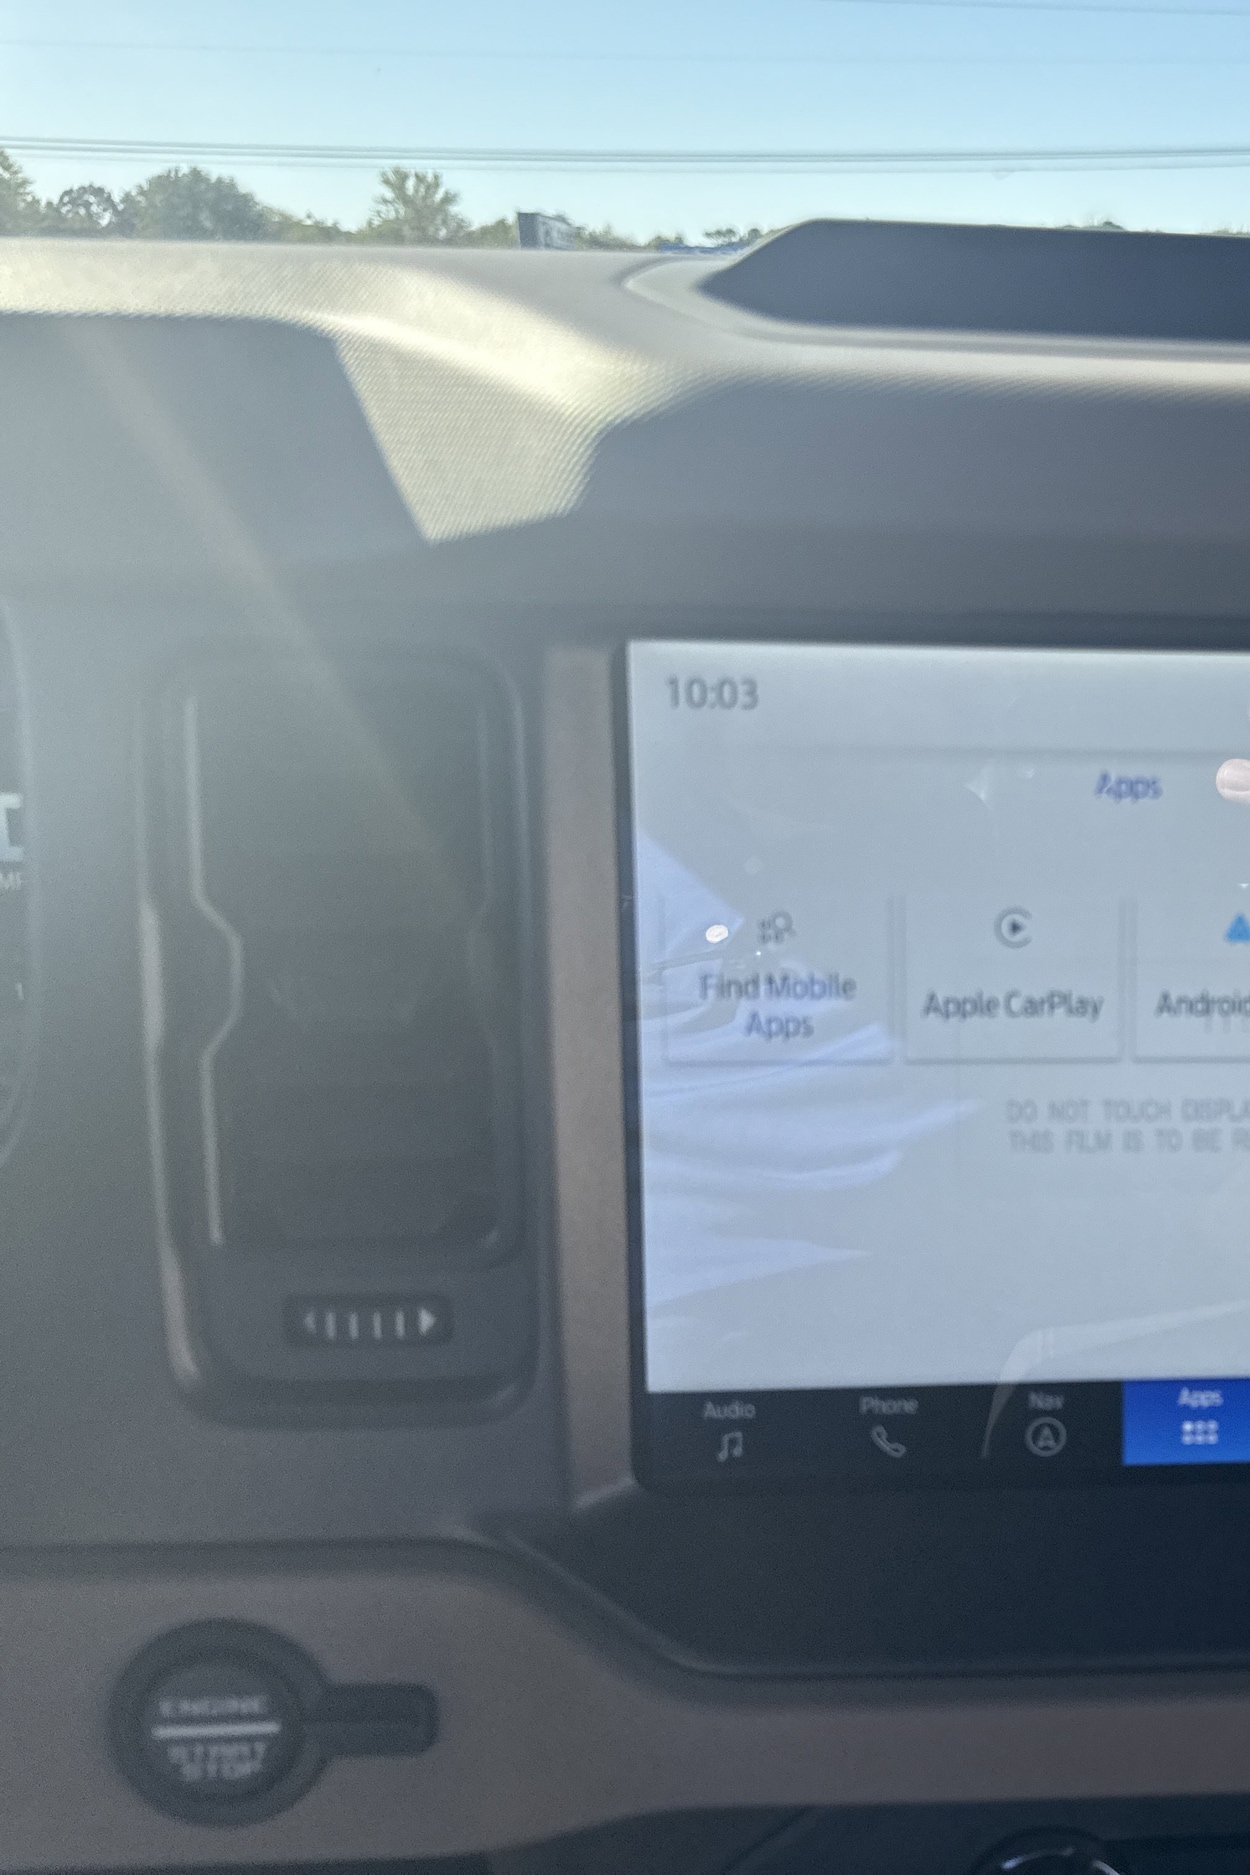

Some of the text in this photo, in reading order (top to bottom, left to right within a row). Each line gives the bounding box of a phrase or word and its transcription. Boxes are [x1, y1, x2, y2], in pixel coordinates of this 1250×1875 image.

[666, 677, 759, 709] 10:03
[1095, 772, 1162, 802] Apps
[700, 972, 857, 1001] Find Mobile
[923, 991, 1103, 1023] Apple CarPlay
[745, 1011, 813, 1040] Apps
[1006, 1097, 1038, 1123] DO
[1048, 1098, 1091, 1123] NOT
[1103, 1098, 1172, 1123] TOUCH
[1009, 1128, 1055, 1154] THIS
[1065, 1128, 1112, 1153] FILM
[1121, 1128, 1144, 1153] IS
[1155, 1128, 1183, 1153] TO
[1191, 1127, 1222, 1153] BE
[703, 1400, 755, 1420] Audio
[860, 1396, 919, 1415] Phone
[1029, 1391, 1064, 1410] Nav
[1178, 1387, 1223, 1408] Apps
